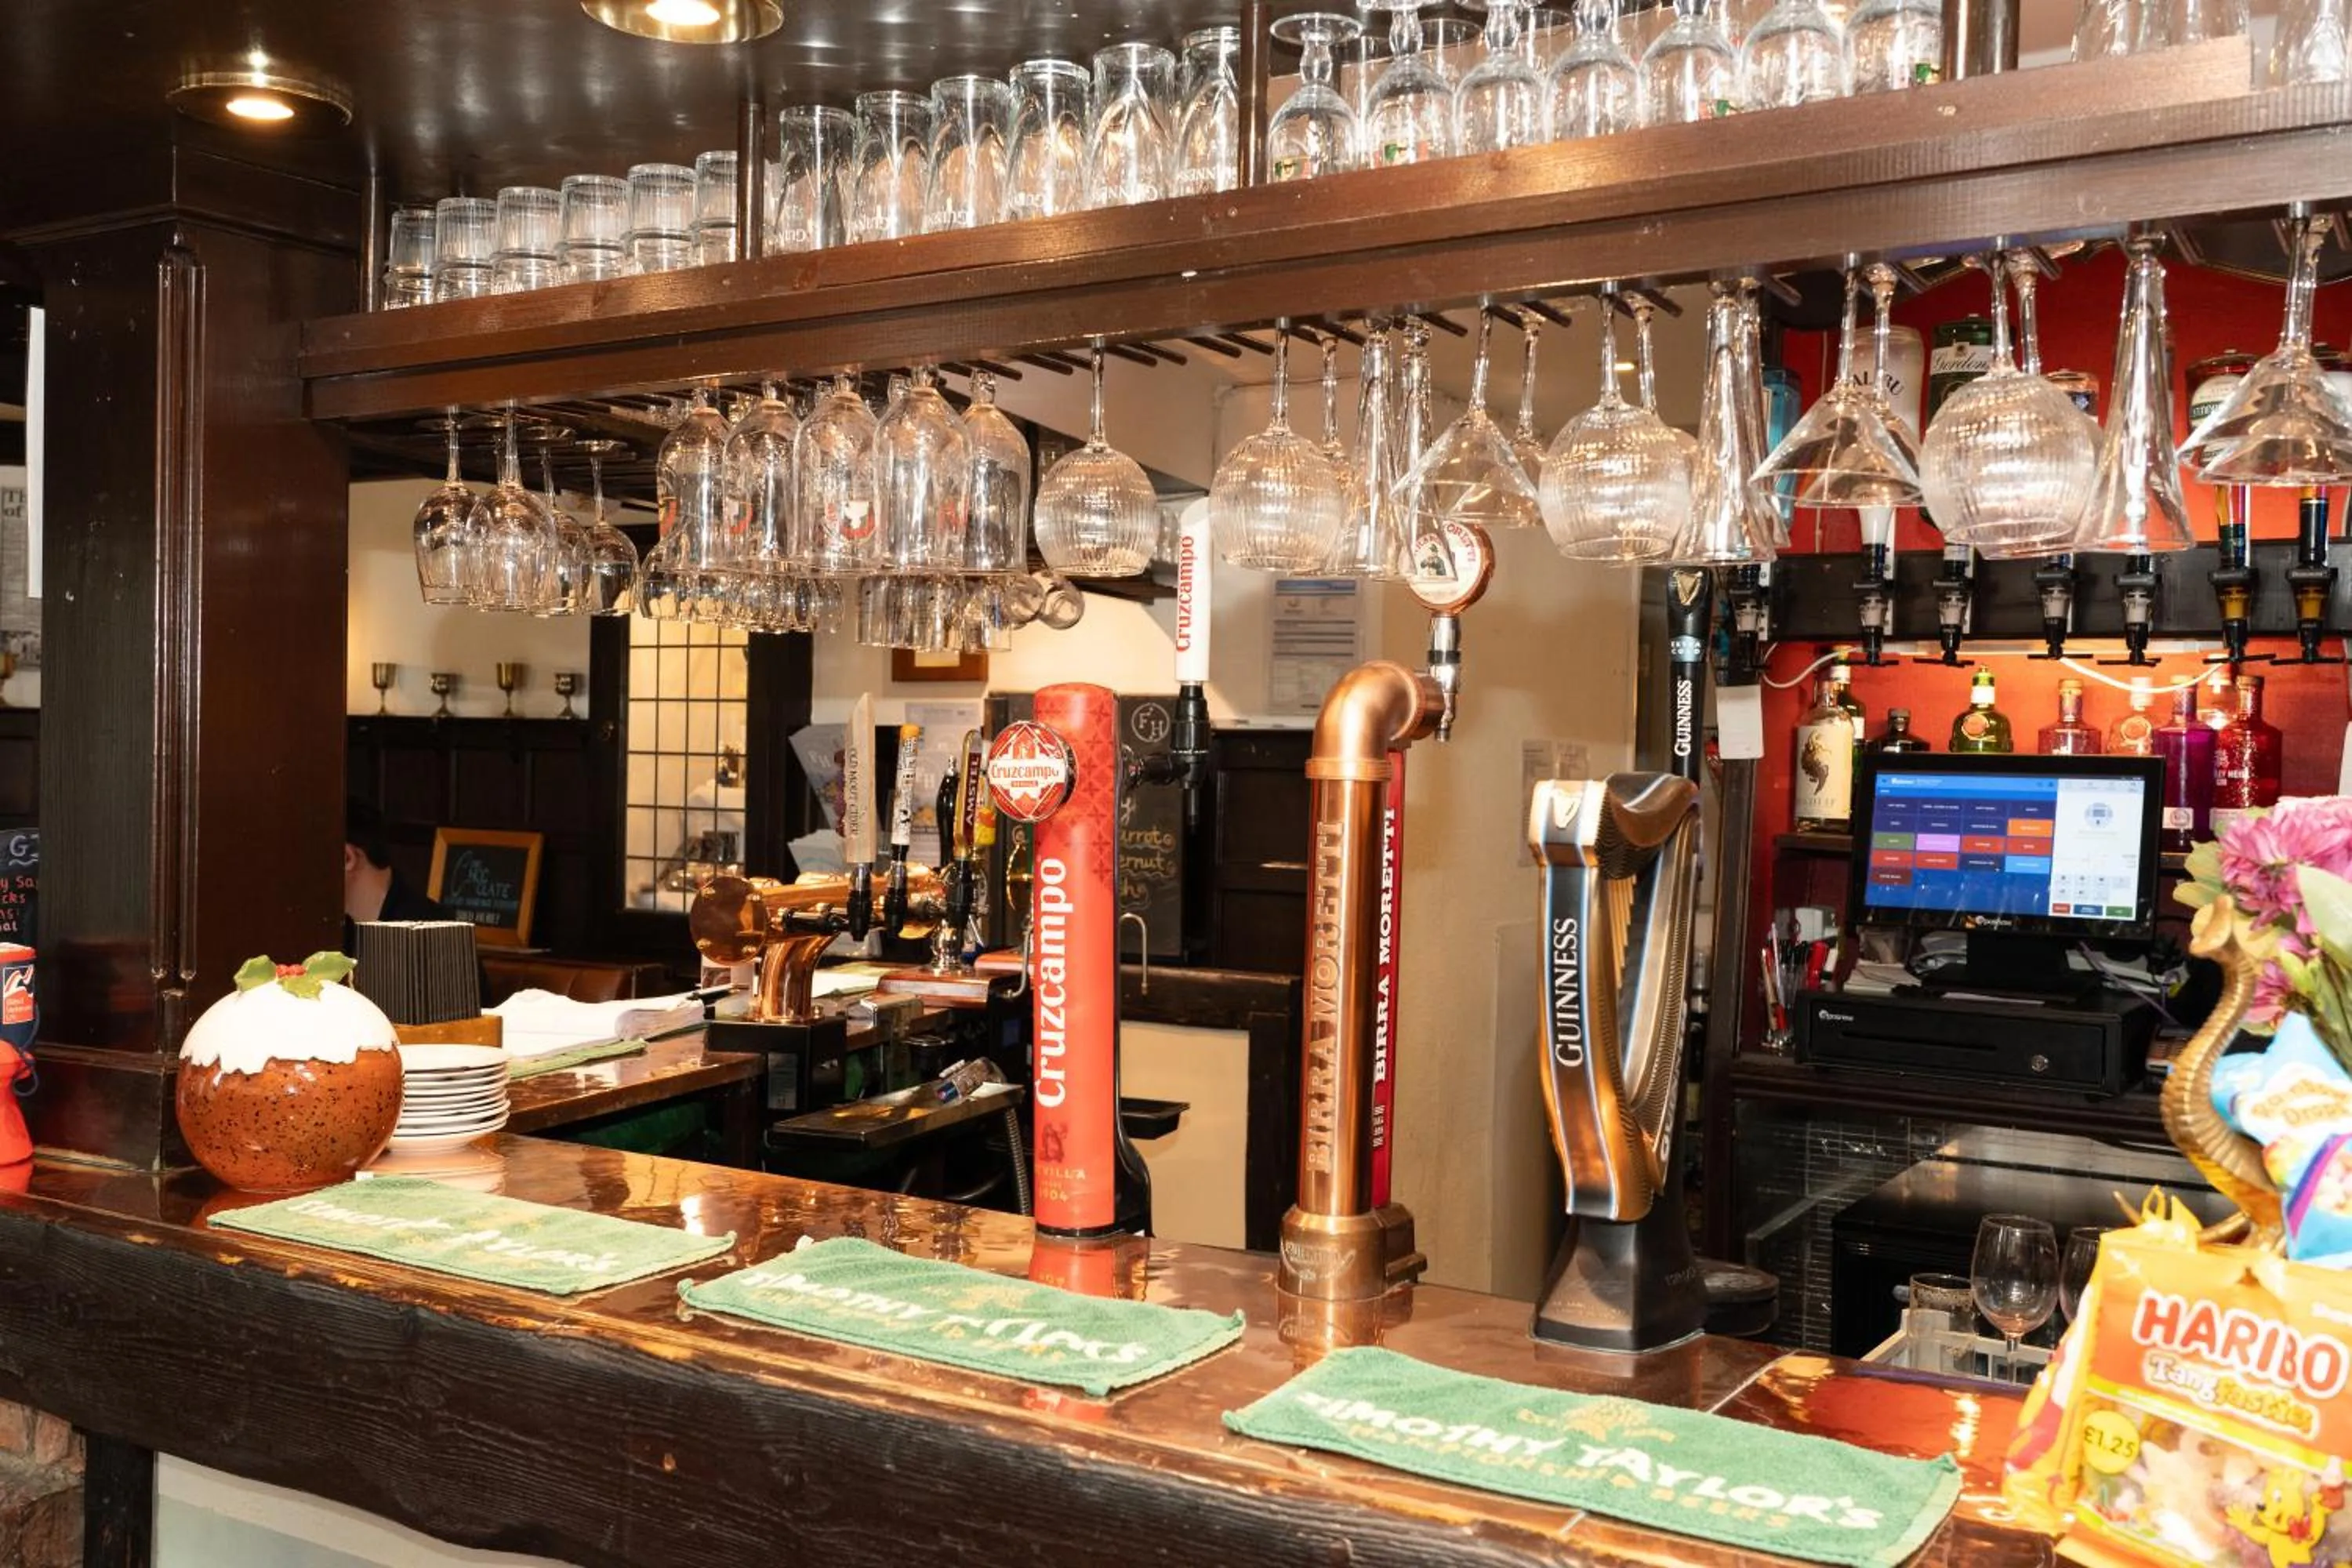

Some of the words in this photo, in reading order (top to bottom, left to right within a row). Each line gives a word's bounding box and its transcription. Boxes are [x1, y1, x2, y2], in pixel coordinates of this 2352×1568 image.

[1176, 535, 1198, 652] Cruzcampo
[1674, 679, 1693, 757] GUINNESS
[965, 756, 980, 826] AMSTEL
[1311, 820, 1345, 1021] MORETTI
[1381, 808, 1396, 964] MORETTI
[1036, 858, 1073, 1108] Cruzcampo
[1375, 973, 1391, 1083] BIRRA
[1553, 918, 1584, 1067] GUINNESS
[1305, 1040, 1338, 1174] BIRRA
[2137, 1297, 2342, 1392] HARIBO
[1295, 1392, 1567, 1457] TIMOTHY
[1574, 1444, 1883, 1529] TAYLOR'S
[2082, 1425, 2136, 1459] £1.25
